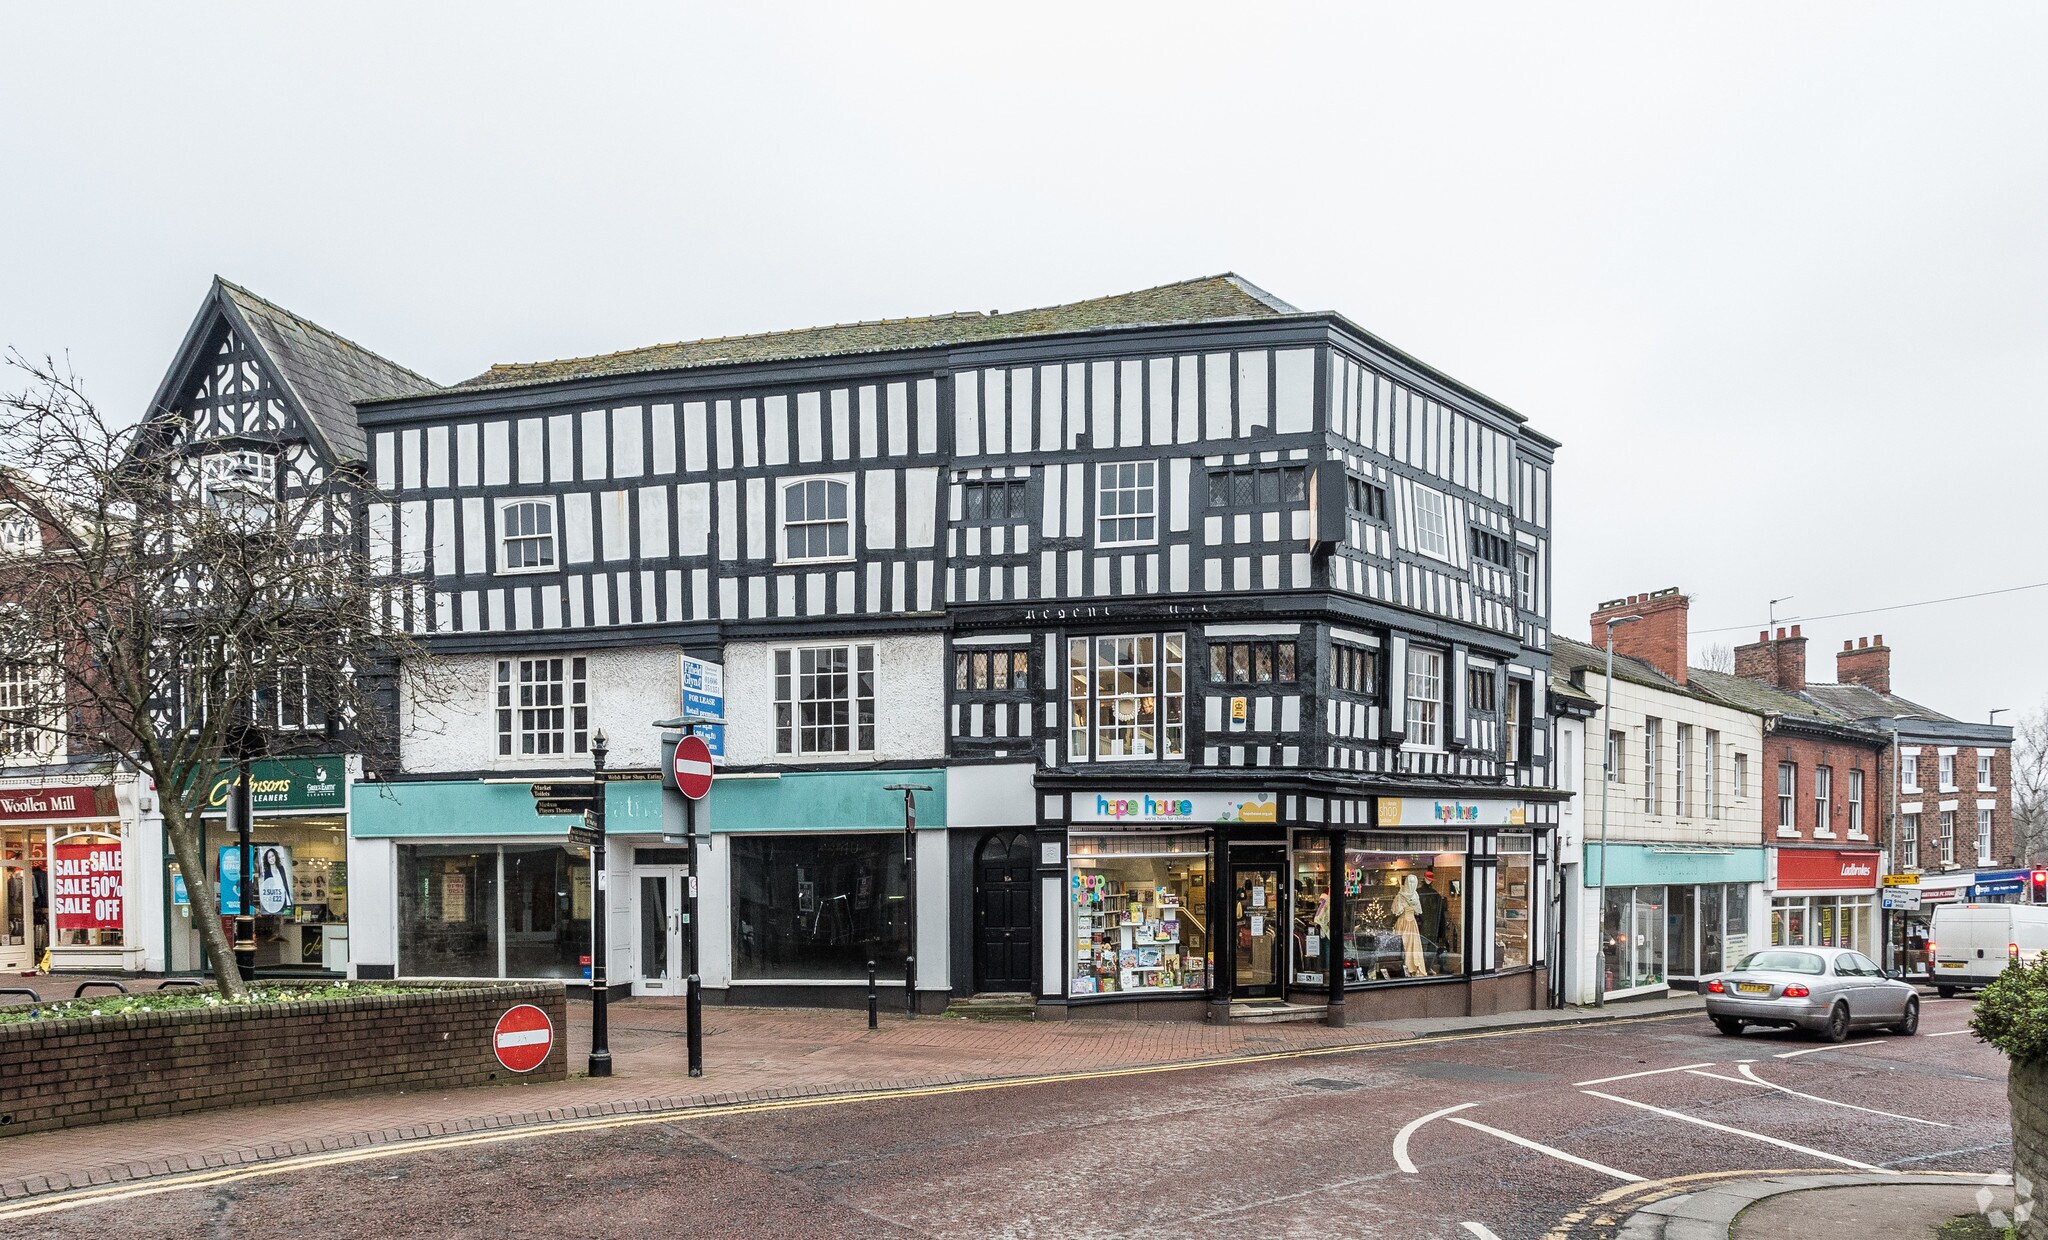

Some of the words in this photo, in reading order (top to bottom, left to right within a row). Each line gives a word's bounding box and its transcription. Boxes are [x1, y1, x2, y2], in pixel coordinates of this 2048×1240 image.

[688, 694, 699, 703] FOR
[699, 696, 716, 705] LEASE
[686, 706, 699, 715] Retail
[1, 797, 47, 813] Woollen
[50, 795, 76, 811] Mill
[252, 794, 288, 802] LEANERS
[1097, 794, 1139, 820] hope
[1144, 794, 1193, 816] house
[1380, 802, 1398, 819] shop
[1435, 800, 1455, 824] hope
[1456, 800, 1478, 820] house
[56, 860, 90, 876] SALE
[90, 851, 122, 872] SALE
[1840, 863, 1871, 877] Ladbrokes
[56, 878, 90, 895] SALE
[91, 876, 123, 897] 50%
[1072, 871, 1105, 893] shop
[267, 888, 282, 896] SUITS
[56, 898, 91, 914] SALE
[95, 900, 120, 920] OFF
